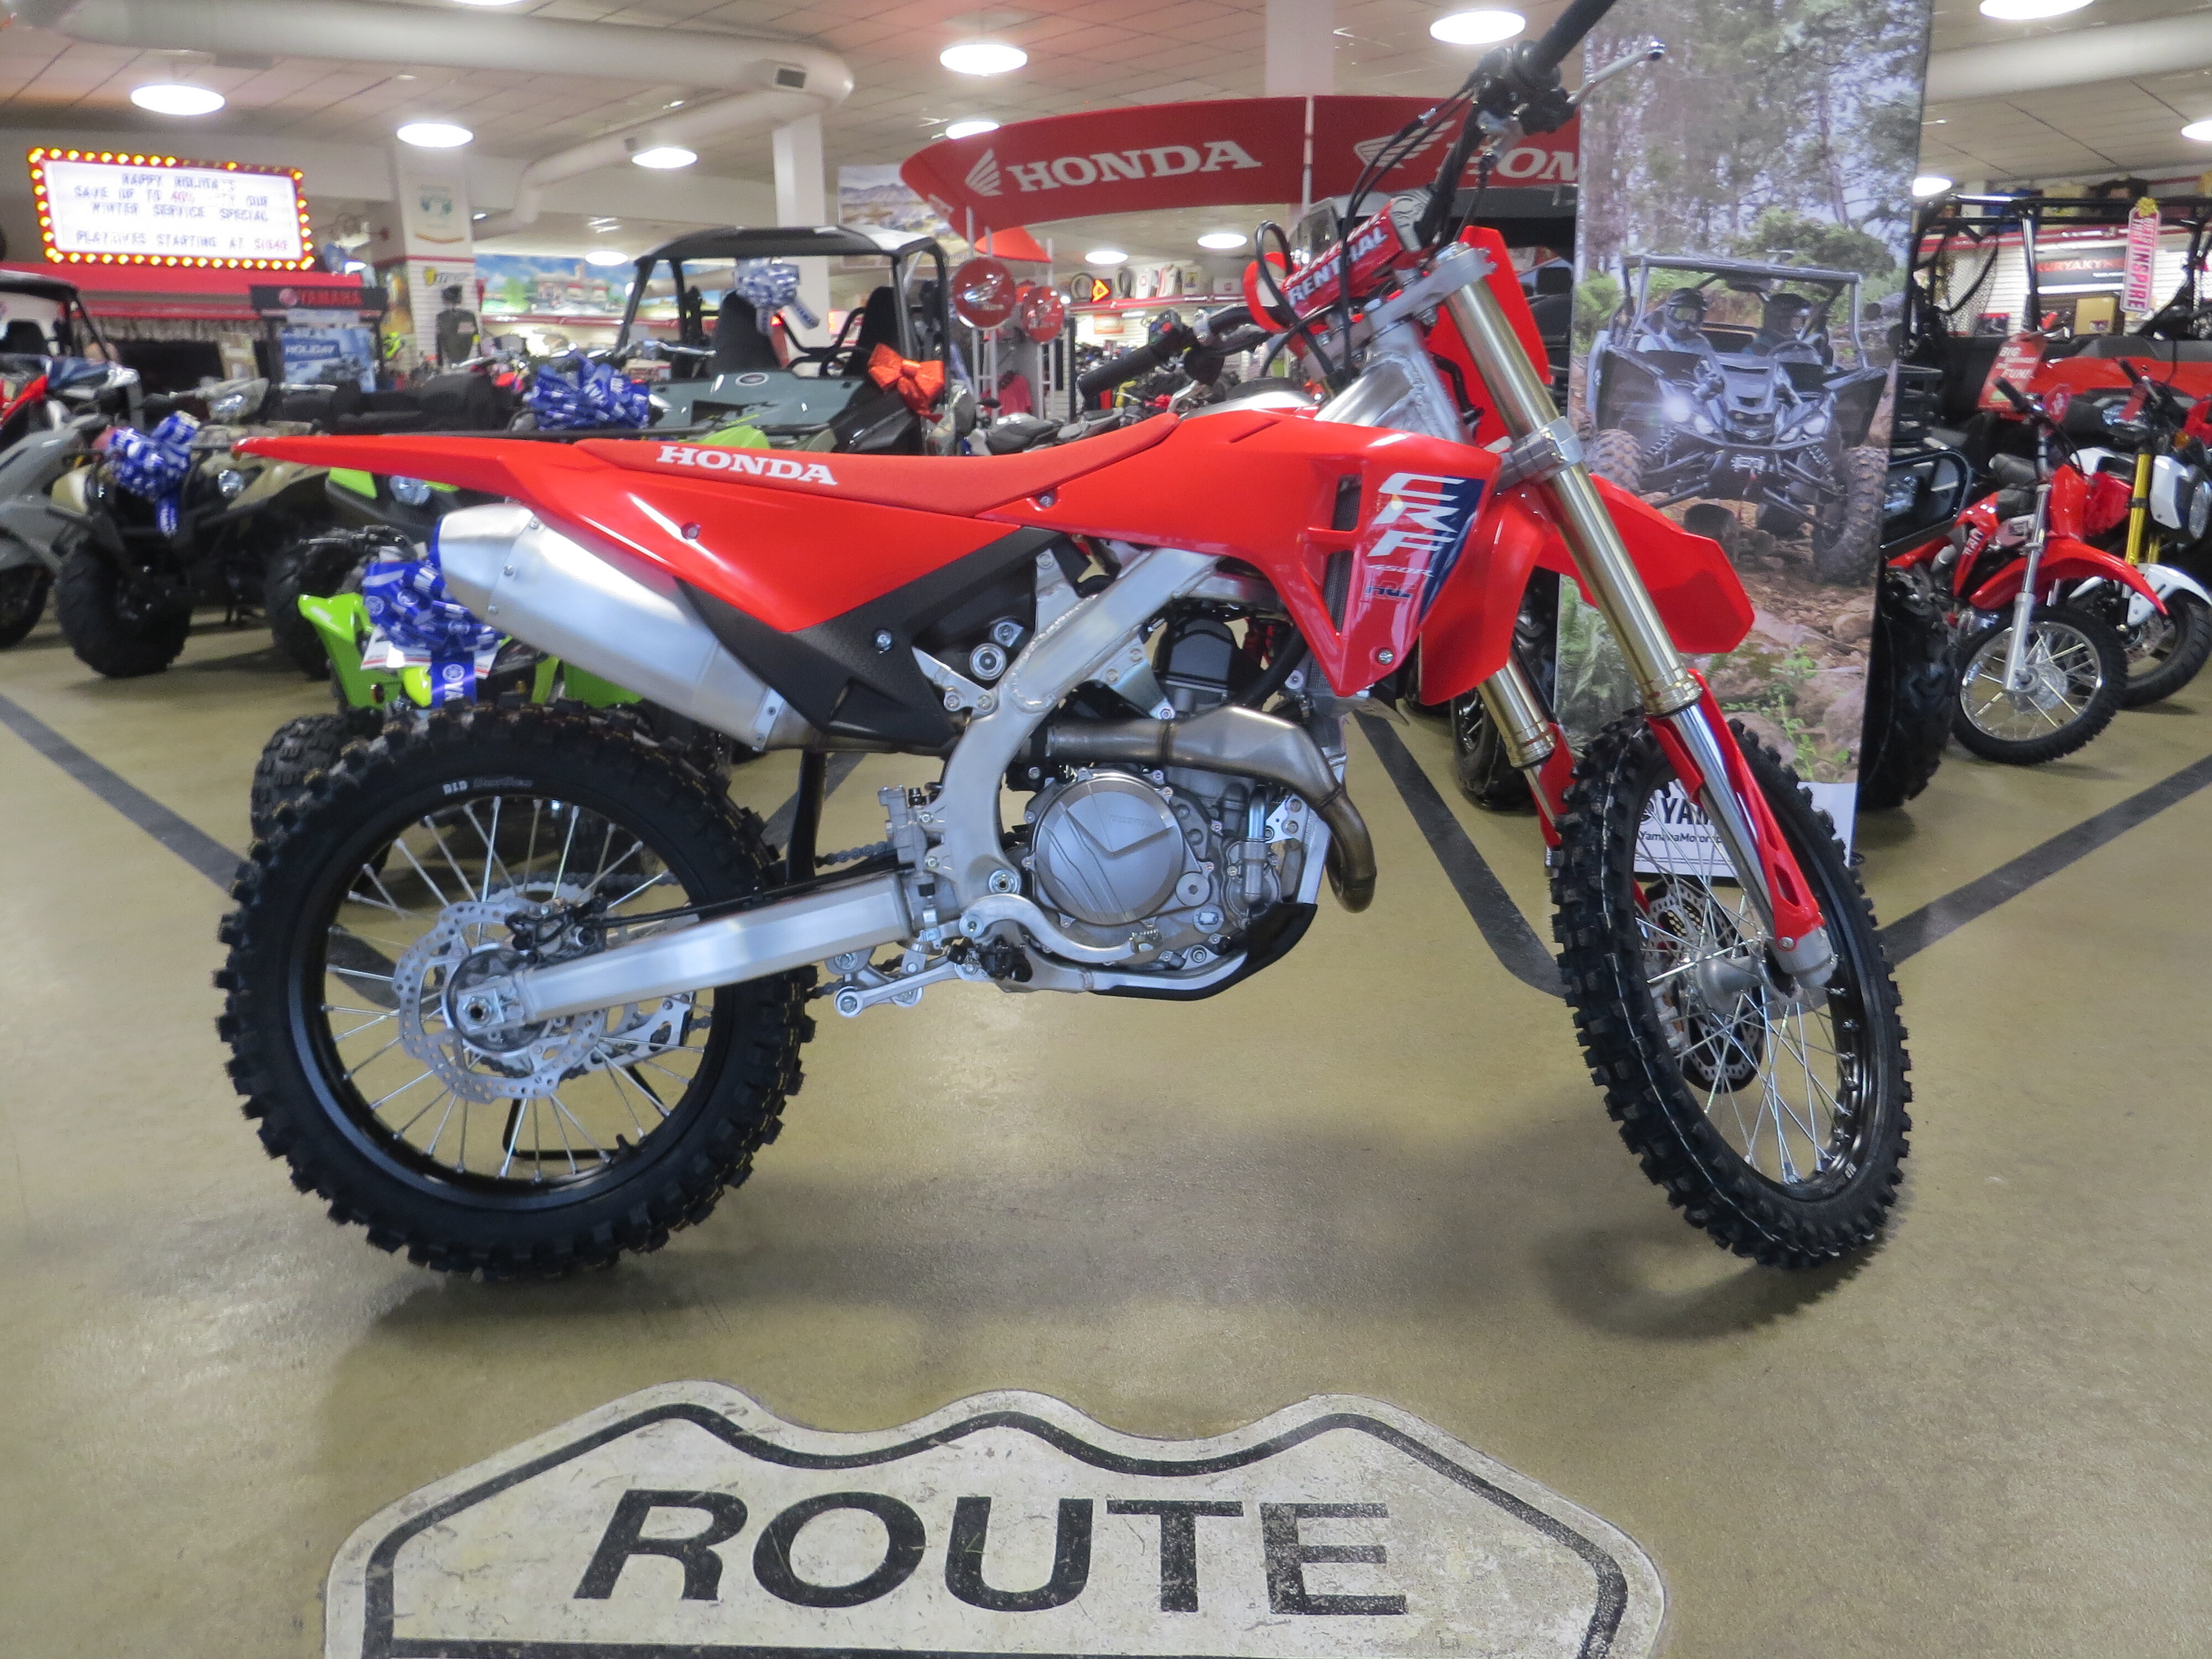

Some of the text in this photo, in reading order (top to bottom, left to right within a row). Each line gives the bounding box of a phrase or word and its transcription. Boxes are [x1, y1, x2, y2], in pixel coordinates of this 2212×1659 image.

[121, 173, 163, 186] HAPPY
[1005, 140, 1262, 192] HONDA
[74, 185, 108, 198] SAVE
[118, 188, 134, 200] UP
[147, 189, 161, 201] TO
[92, 201, 269, 222] WINTER SERVICE SPECIAL
[156, 233, 217, 248] STARTING
[228, 237, 245, 250] AT
[2128, 247, 2151, 309] INSPIRE
[656, 445, 838, 486] HONDA
[1366, 472, 1467, 557] CRF
[573, 1489, 1410, 1613] ROUTE
